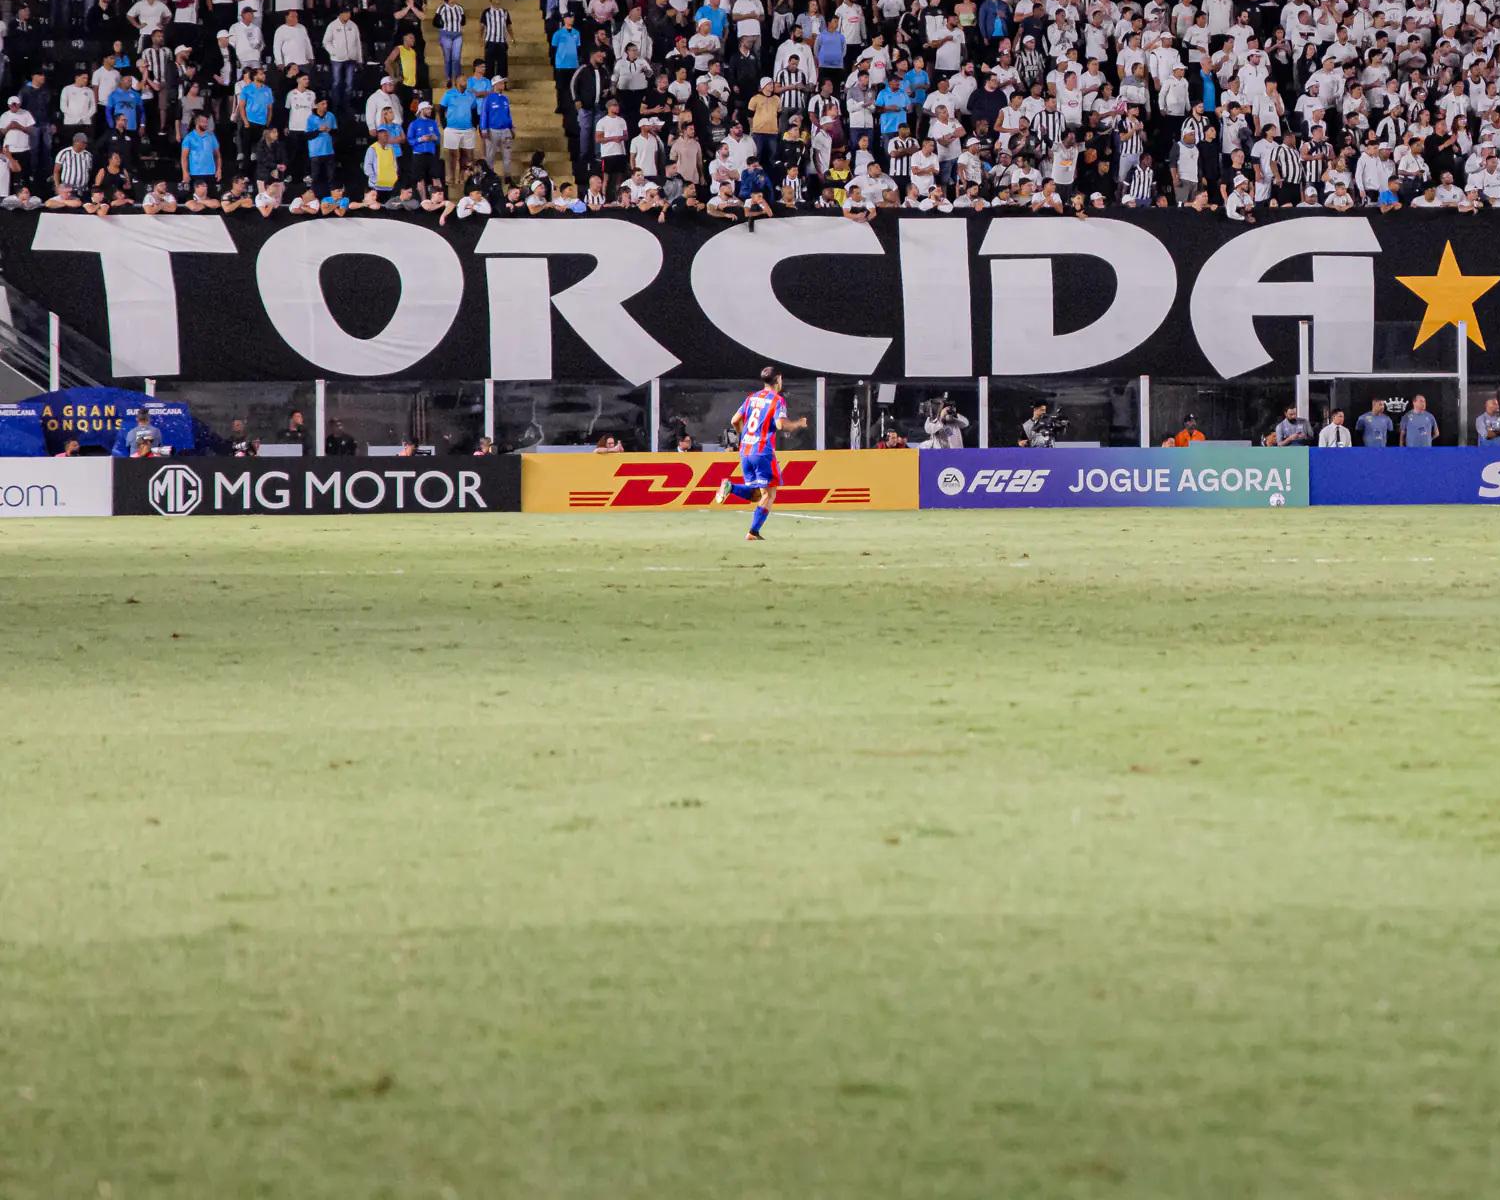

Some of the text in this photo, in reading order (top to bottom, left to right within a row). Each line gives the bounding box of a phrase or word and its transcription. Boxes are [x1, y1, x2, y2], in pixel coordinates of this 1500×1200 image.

[31, 212, 1382, 386] TORCIDA
[42, 405, 53, 416] A
[747, 408, 761, 433] 6
[41, 418, 122, 433] ONQUIS
[214, 470, 488, 510] MG MOTOR
[610, 460, 831, 507] DHL
[943, 474, 960, 483] EA
[967, 469, 1051, 493] FC26
[1068, 467, 1292, 492] JOGUE AGORA!
